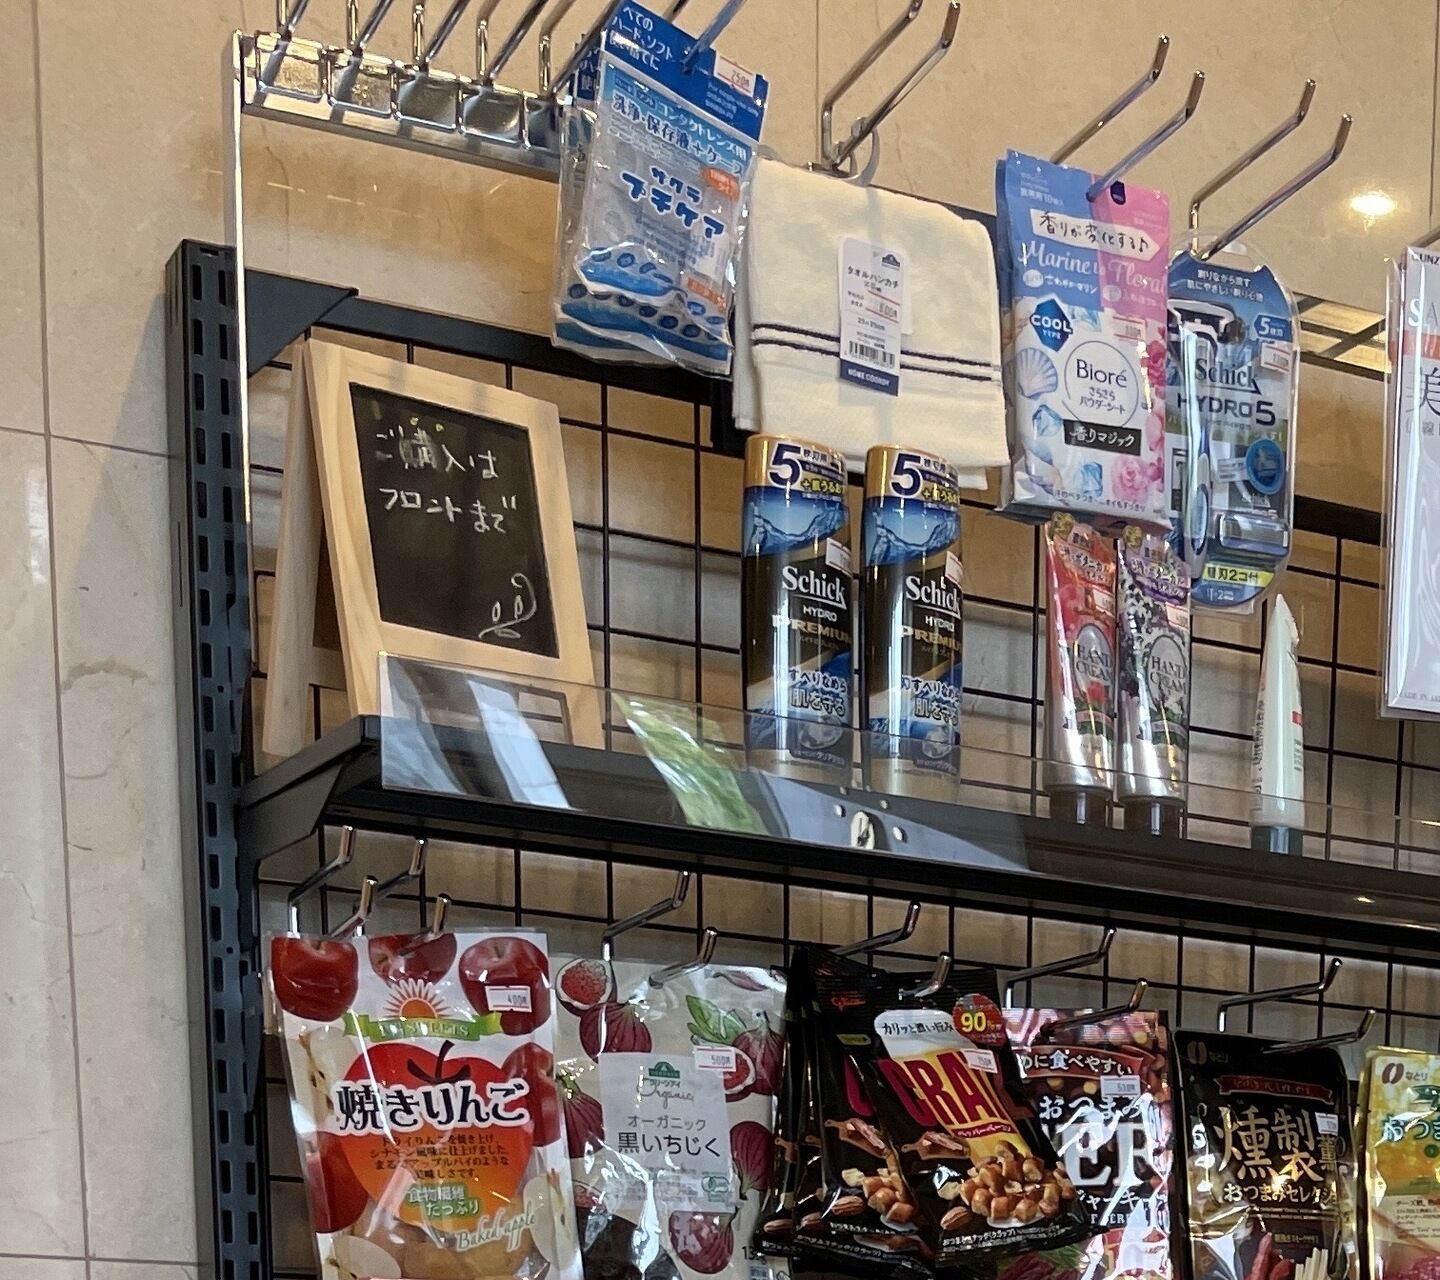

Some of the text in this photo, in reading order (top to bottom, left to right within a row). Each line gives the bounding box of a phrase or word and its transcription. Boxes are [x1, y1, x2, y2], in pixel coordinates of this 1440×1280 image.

[1017, 240, 1094, 276] Marine
[1030, 313, 1072, 334] COOL
[1075, 358, 1128, 389] Bioré
[1194, 356, 1263, 396] Schick
[1069, 425, 1136, 448] 香りマジック
[769, 442, 803, 488] 5
[889, 452, 923, 497] 5
[379, 487, 518, 534] フロントまで
[781, 565, 846, 605] Schick
[904, 575, 961, 616] Schick
[802, 604, 838, 623] HYDRO
[924, 615, 956, 634] HYDRO
[960, 1011, 987, 1033] 90
[336, 1083, 528, 1132] 焼きりんご
[627, 1114, 707, 1132] オーガニック
[617, 1131, 721, 1158] 黒いちじく
[457, 1207, 538, 1250] Baked apple
